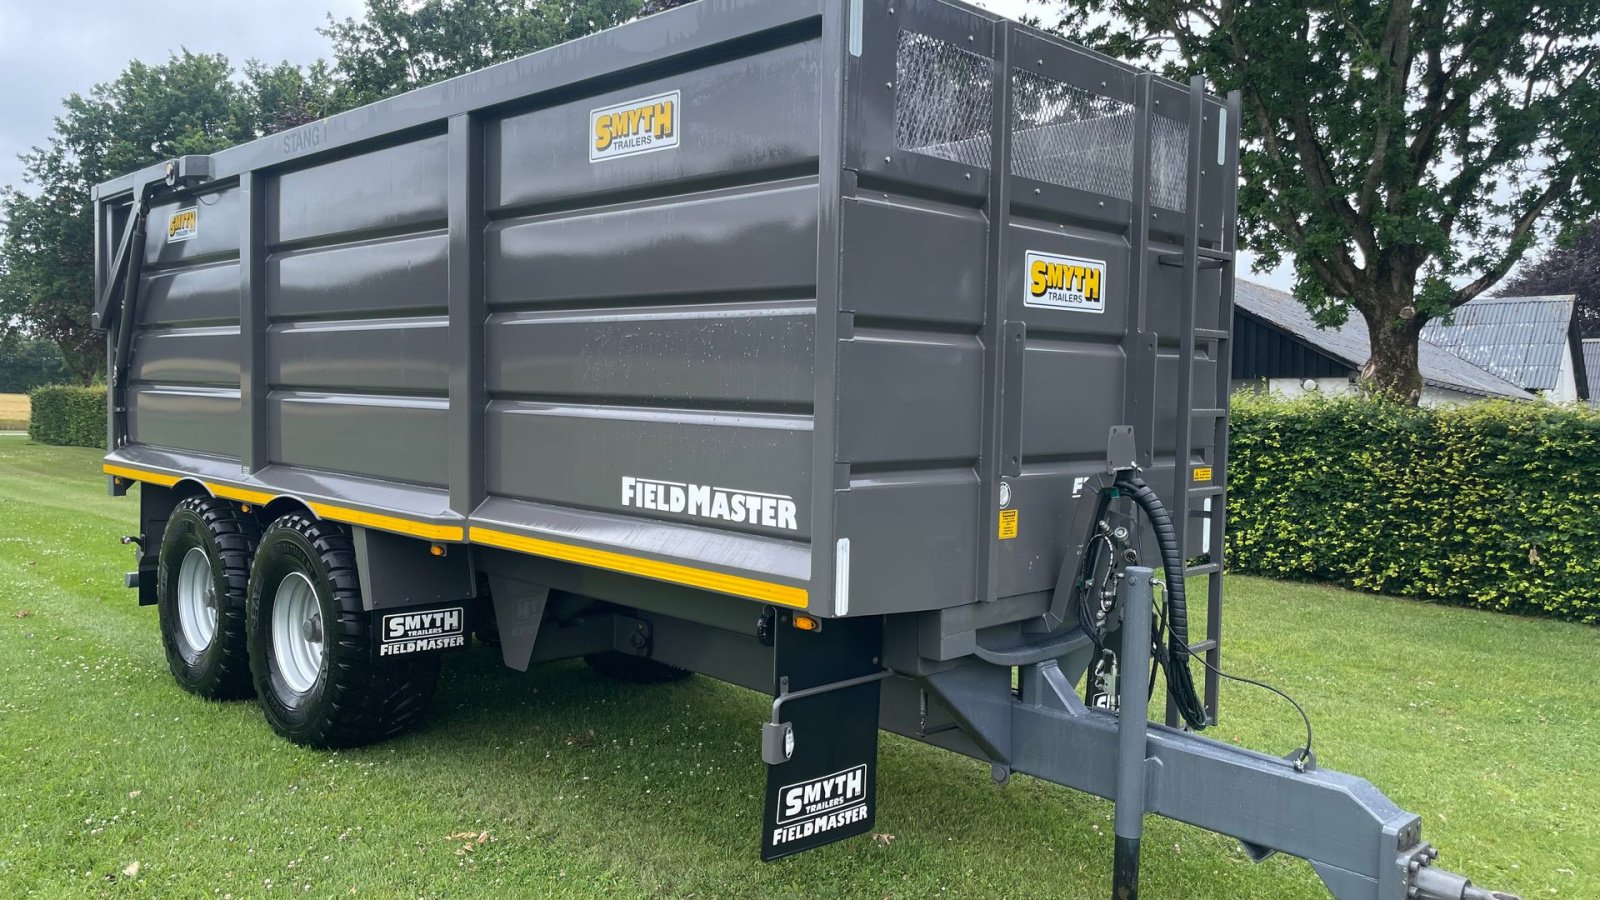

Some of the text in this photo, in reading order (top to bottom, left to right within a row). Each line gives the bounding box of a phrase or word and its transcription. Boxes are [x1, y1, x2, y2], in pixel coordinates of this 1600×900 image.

[283, 126, 320, 154] STANG
[595, 101, 674, 152] SMYTH
[613, 135, 652, 151] TRAILERS
[1031, 260, 1101, 302] SMYTH
[1048, 292, 1083, 303] TRAILERS
[389, 610, 459, 638] SMYTH
[407, 627, 443, 637] TRAILERS
[785, 769, 862, 817] SMYTH
[805, 796, 844, 814] TRAILERS
